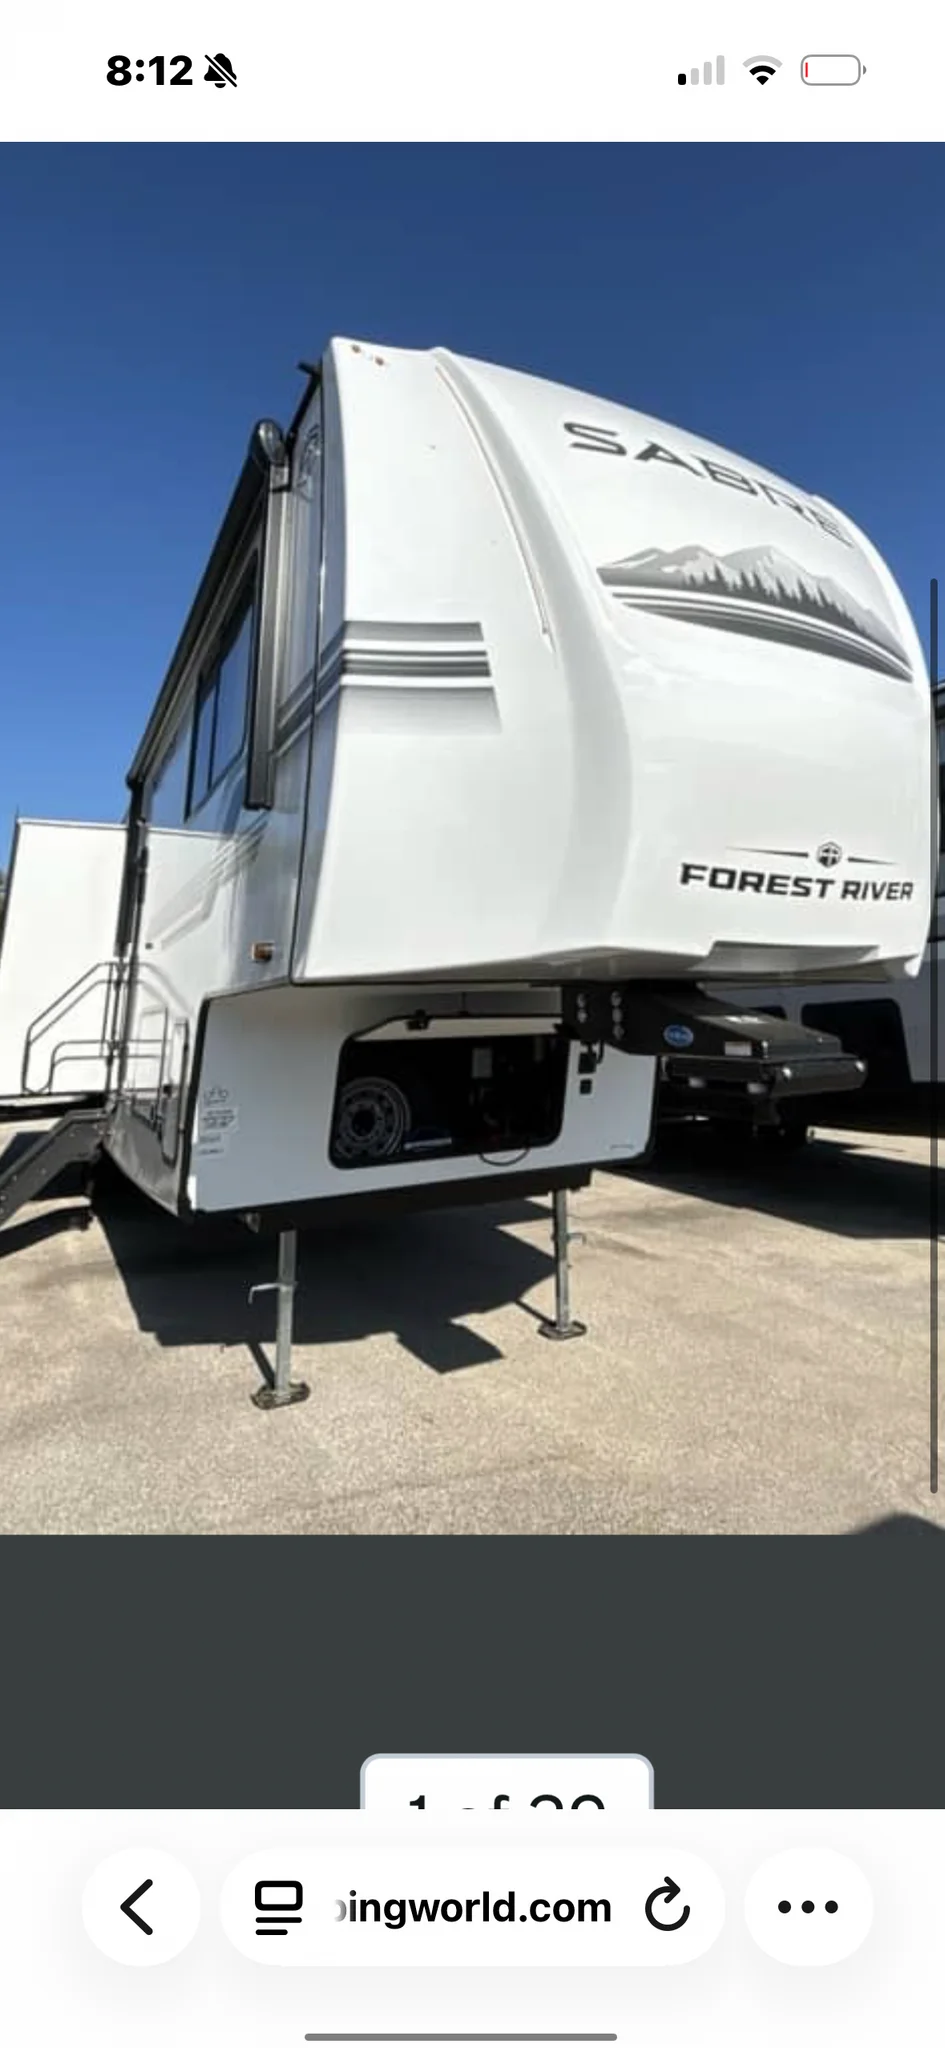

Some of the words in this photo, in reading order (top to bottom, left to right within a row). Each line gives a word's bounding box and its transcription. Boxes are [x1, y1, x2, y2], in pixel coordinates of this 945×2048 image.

[106, 54, 193, 87] 8:12
[563, 421, 854, 548] SABRE
[680, 861, 835, 899] FOREST
[840, 880, 914, 901] RIVER
